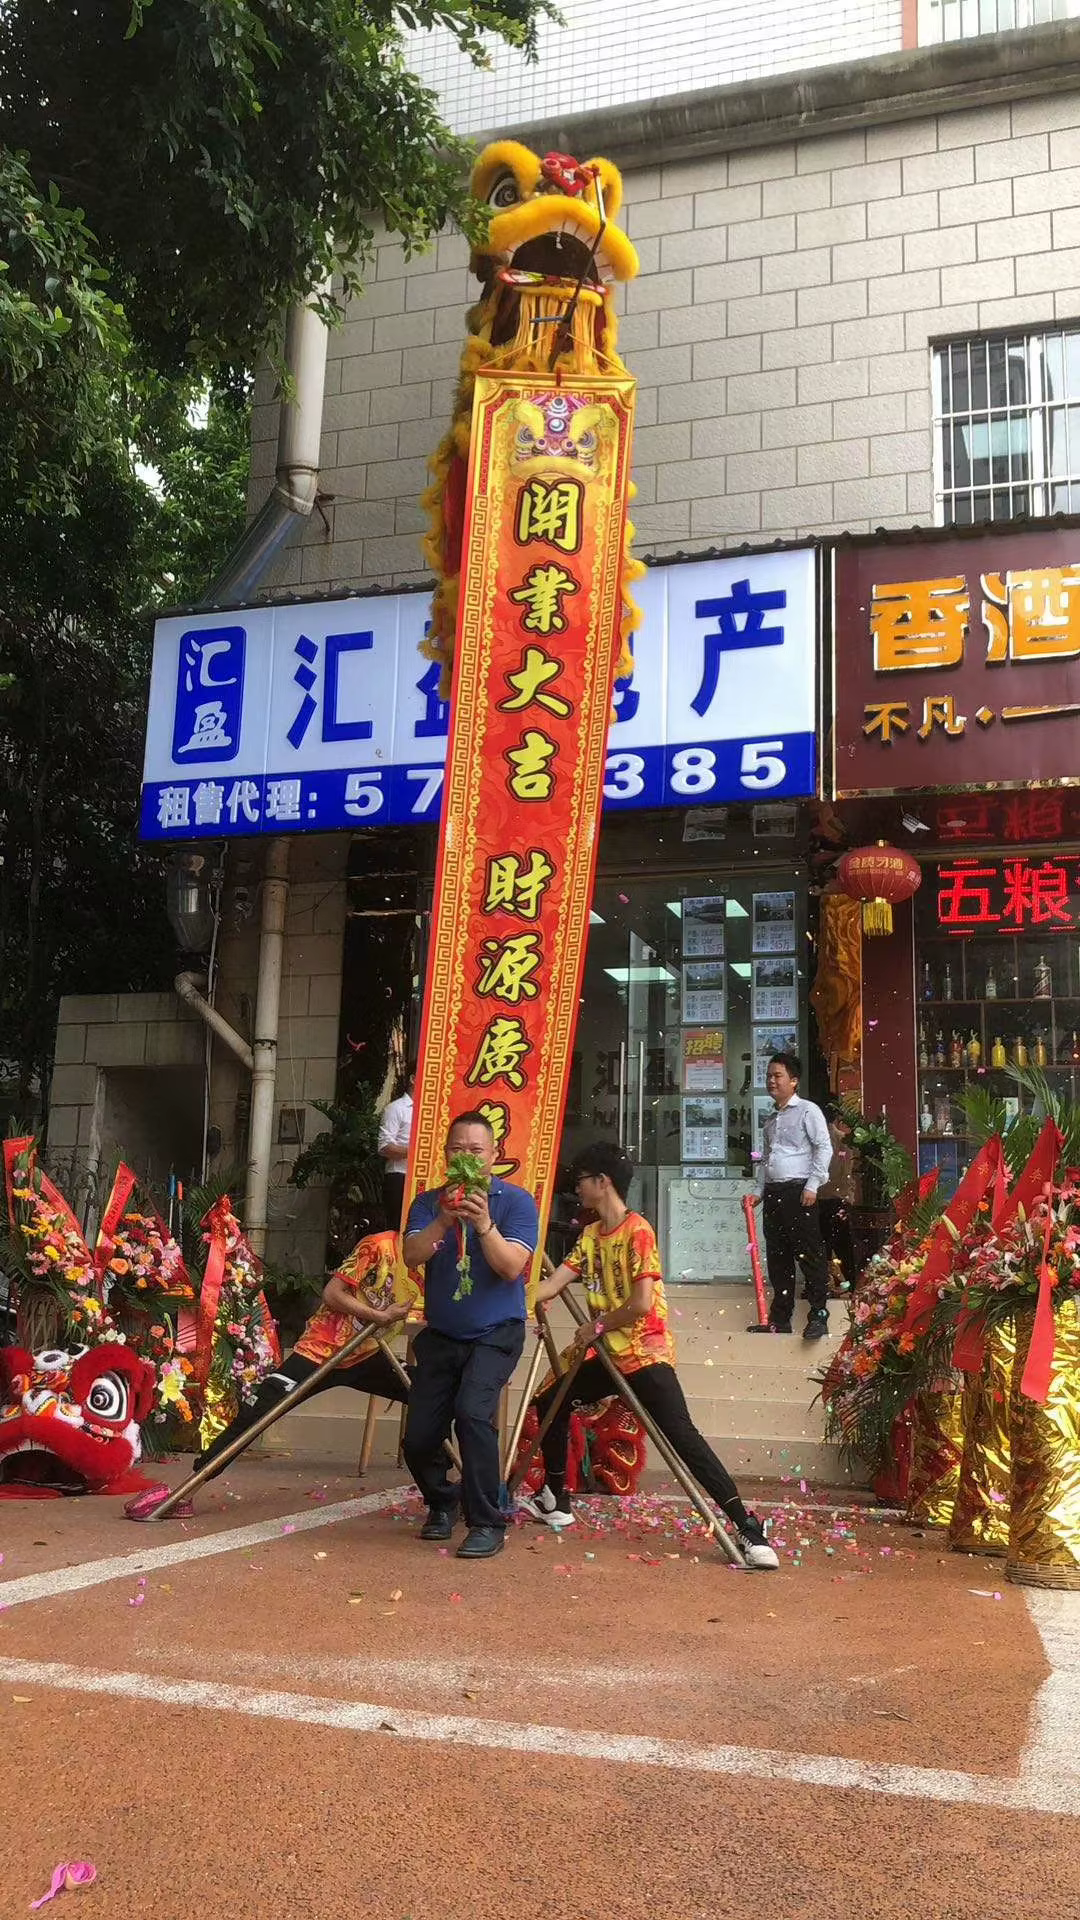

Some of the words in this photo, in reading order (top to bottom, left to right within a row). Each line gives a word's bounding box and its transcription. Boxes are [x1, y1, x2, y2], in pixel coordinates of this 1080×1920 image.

[177, 638, 238, 754] 汇盈
[498, 480, 583, 802] 開業大吉
